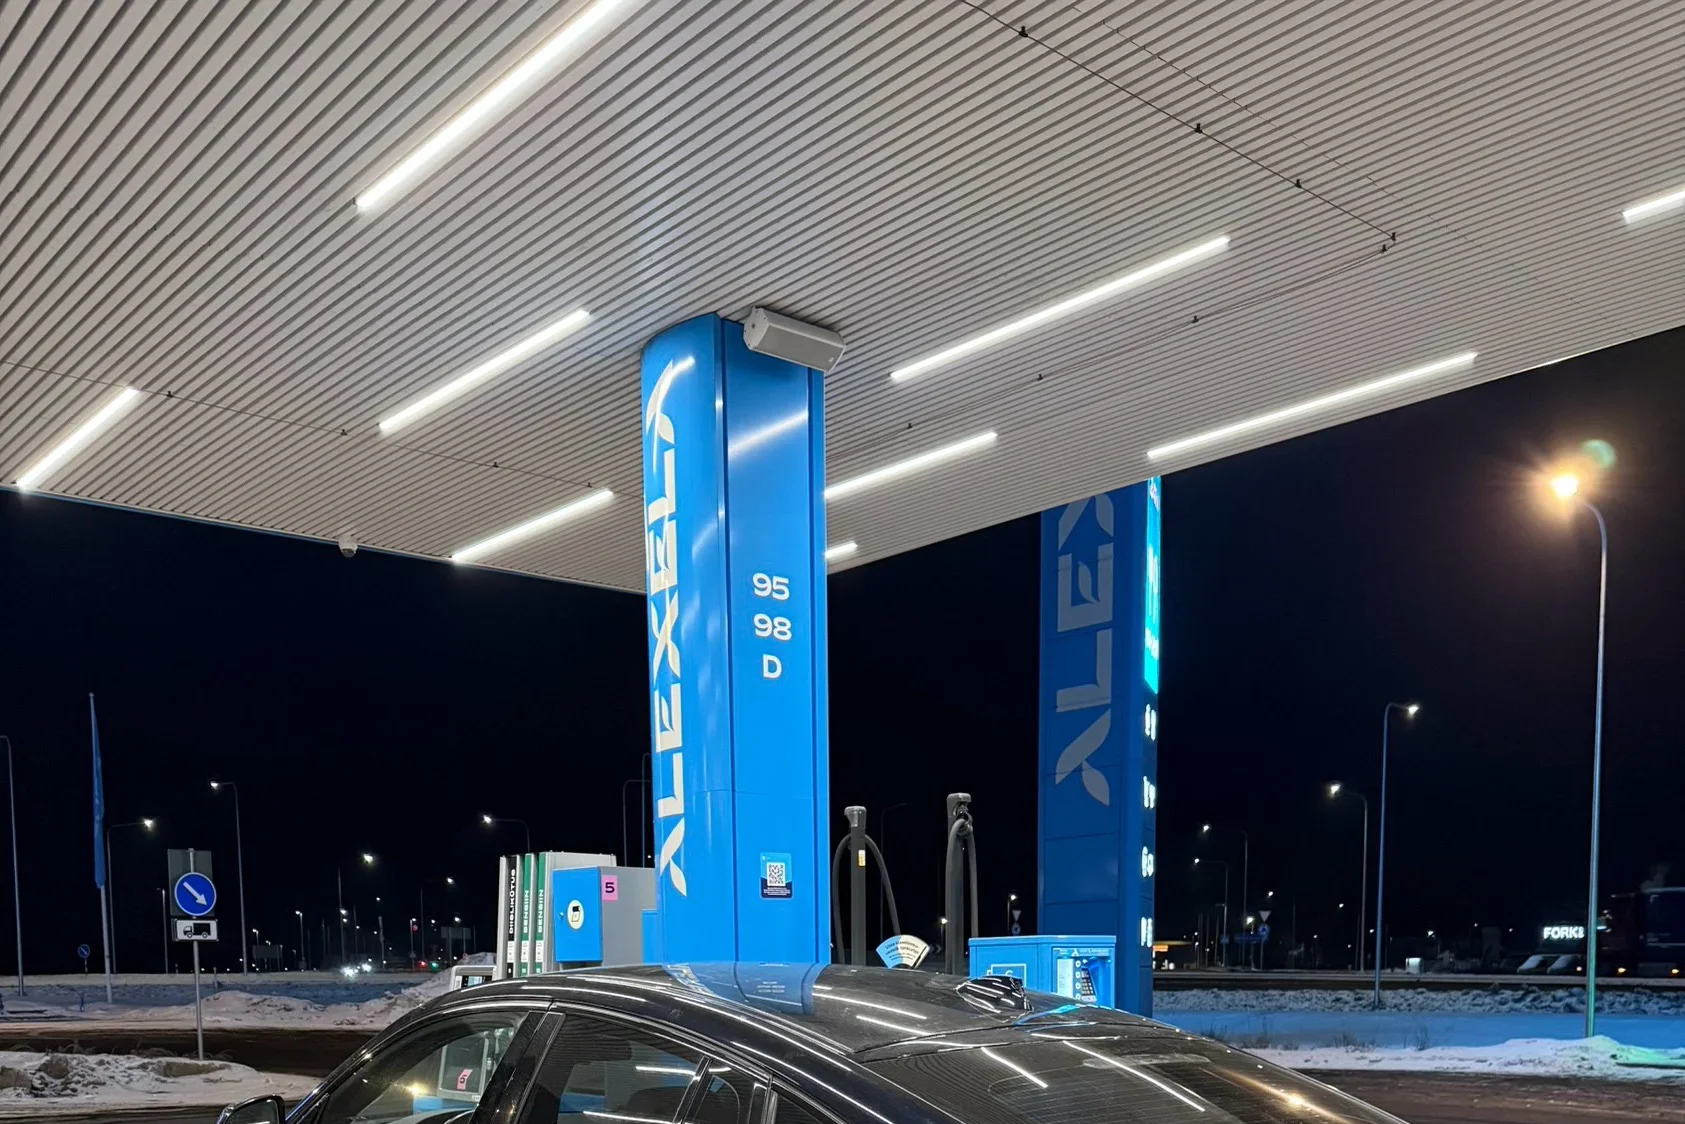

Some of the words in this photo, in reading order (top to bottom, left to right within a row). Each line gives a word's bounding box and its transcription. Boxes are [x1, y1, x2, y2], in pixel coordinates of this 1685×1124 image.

[752, 572, 790, 601] 95
[645, 360, 687, 897] ALEXELA
[753, 613, 792, 641] 98
[762, 653, 782, 679] D
[605, 881, 615, 894] 5
